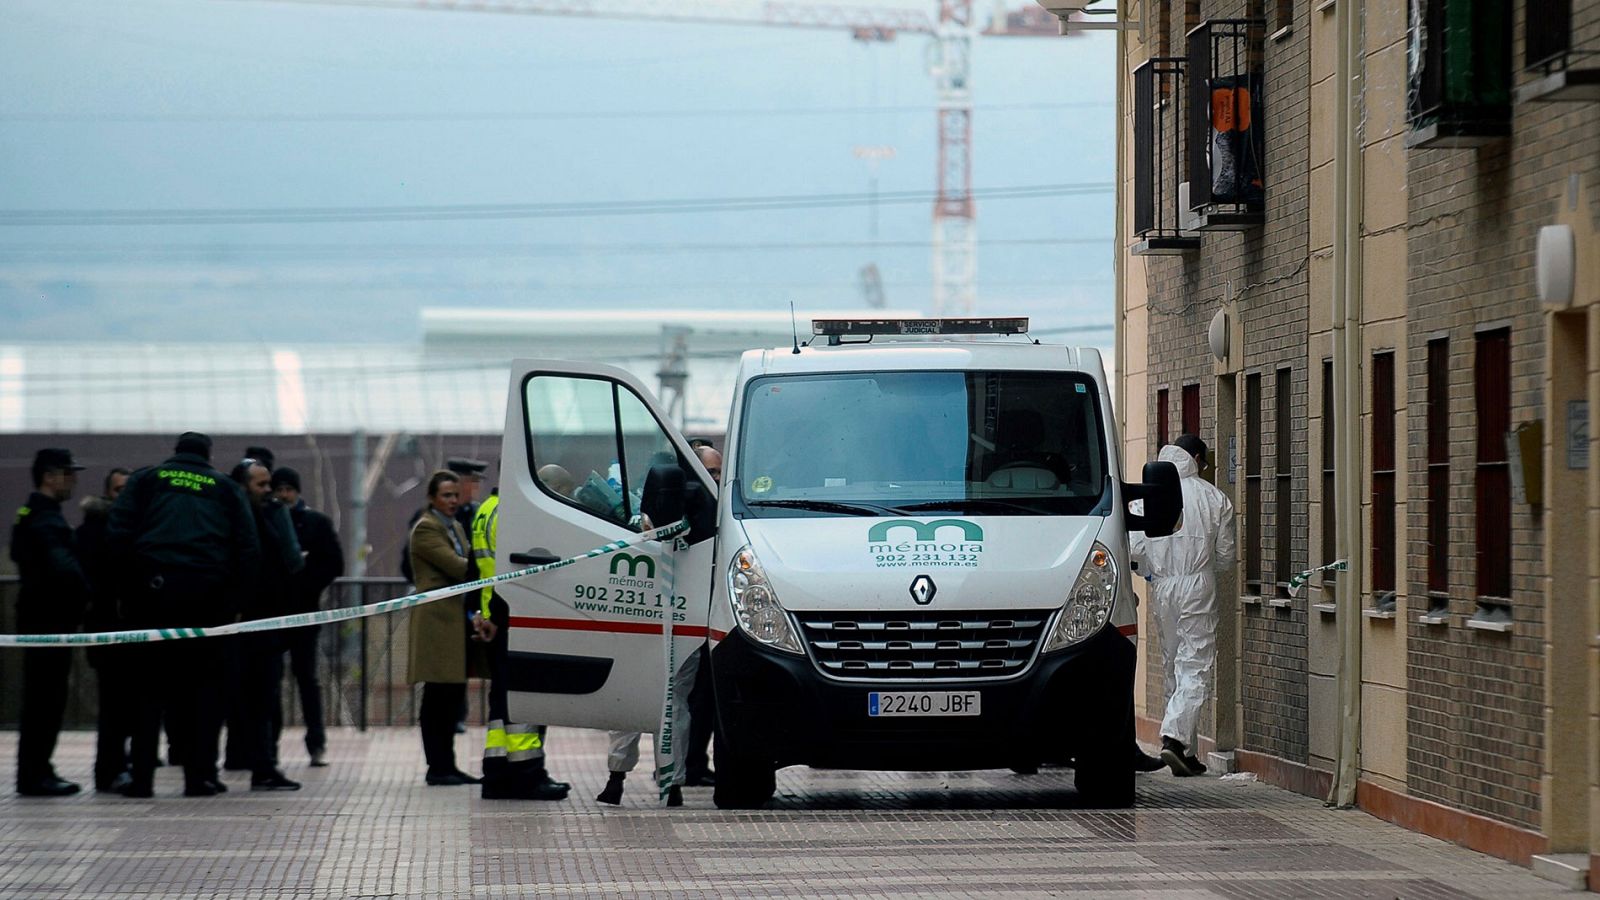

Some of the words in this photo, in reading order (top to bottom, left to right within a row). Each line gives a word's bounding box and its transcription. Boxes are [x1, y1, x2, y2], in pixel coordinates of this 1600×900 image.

[159, 470, 216, 485] GUARDIA
[170, 479, 202, 490] CIVIL
[869, 541, 983, 553] mémora
[875, 554, 905, 562] 902
[608, 576, 655, 589] mémora
[575, 584, 608, 601] 902
[614, 589, 647, 606] 231
[654, 593, 687, 610] 12
[574, 600, 686, 621] www.memoraes
[882, 695, 932, 713] 2240
[939, 695, 976, 713] JBF
